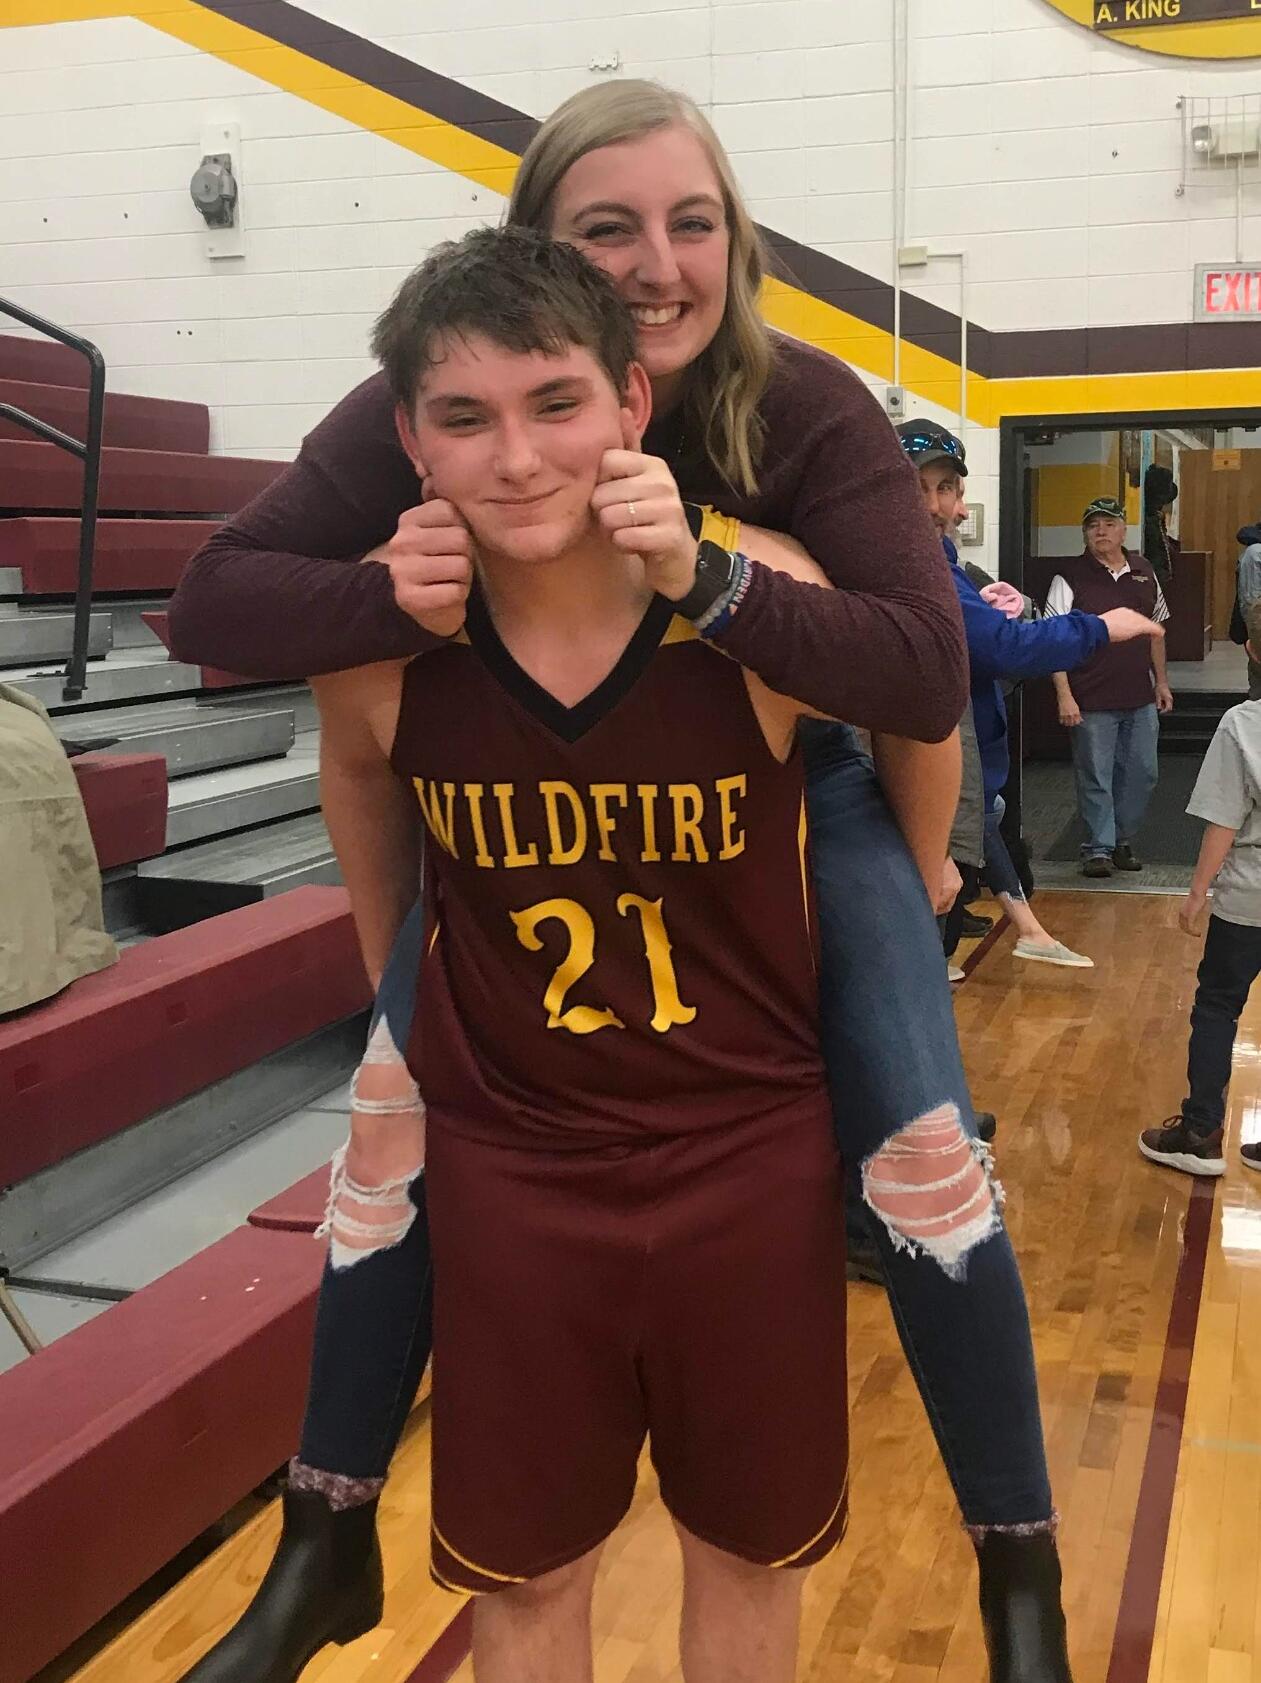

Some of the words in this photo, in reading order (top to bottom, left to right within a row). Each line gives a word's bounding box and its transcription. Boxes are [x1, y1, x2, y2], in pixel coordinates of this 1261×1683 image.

[1097, 3, 1118, 23] A.
[1125, 0, 1181, 21] KING
[412, 773, 747, 869] WILDFIRE
[509, 892, 697, 1035] 21
